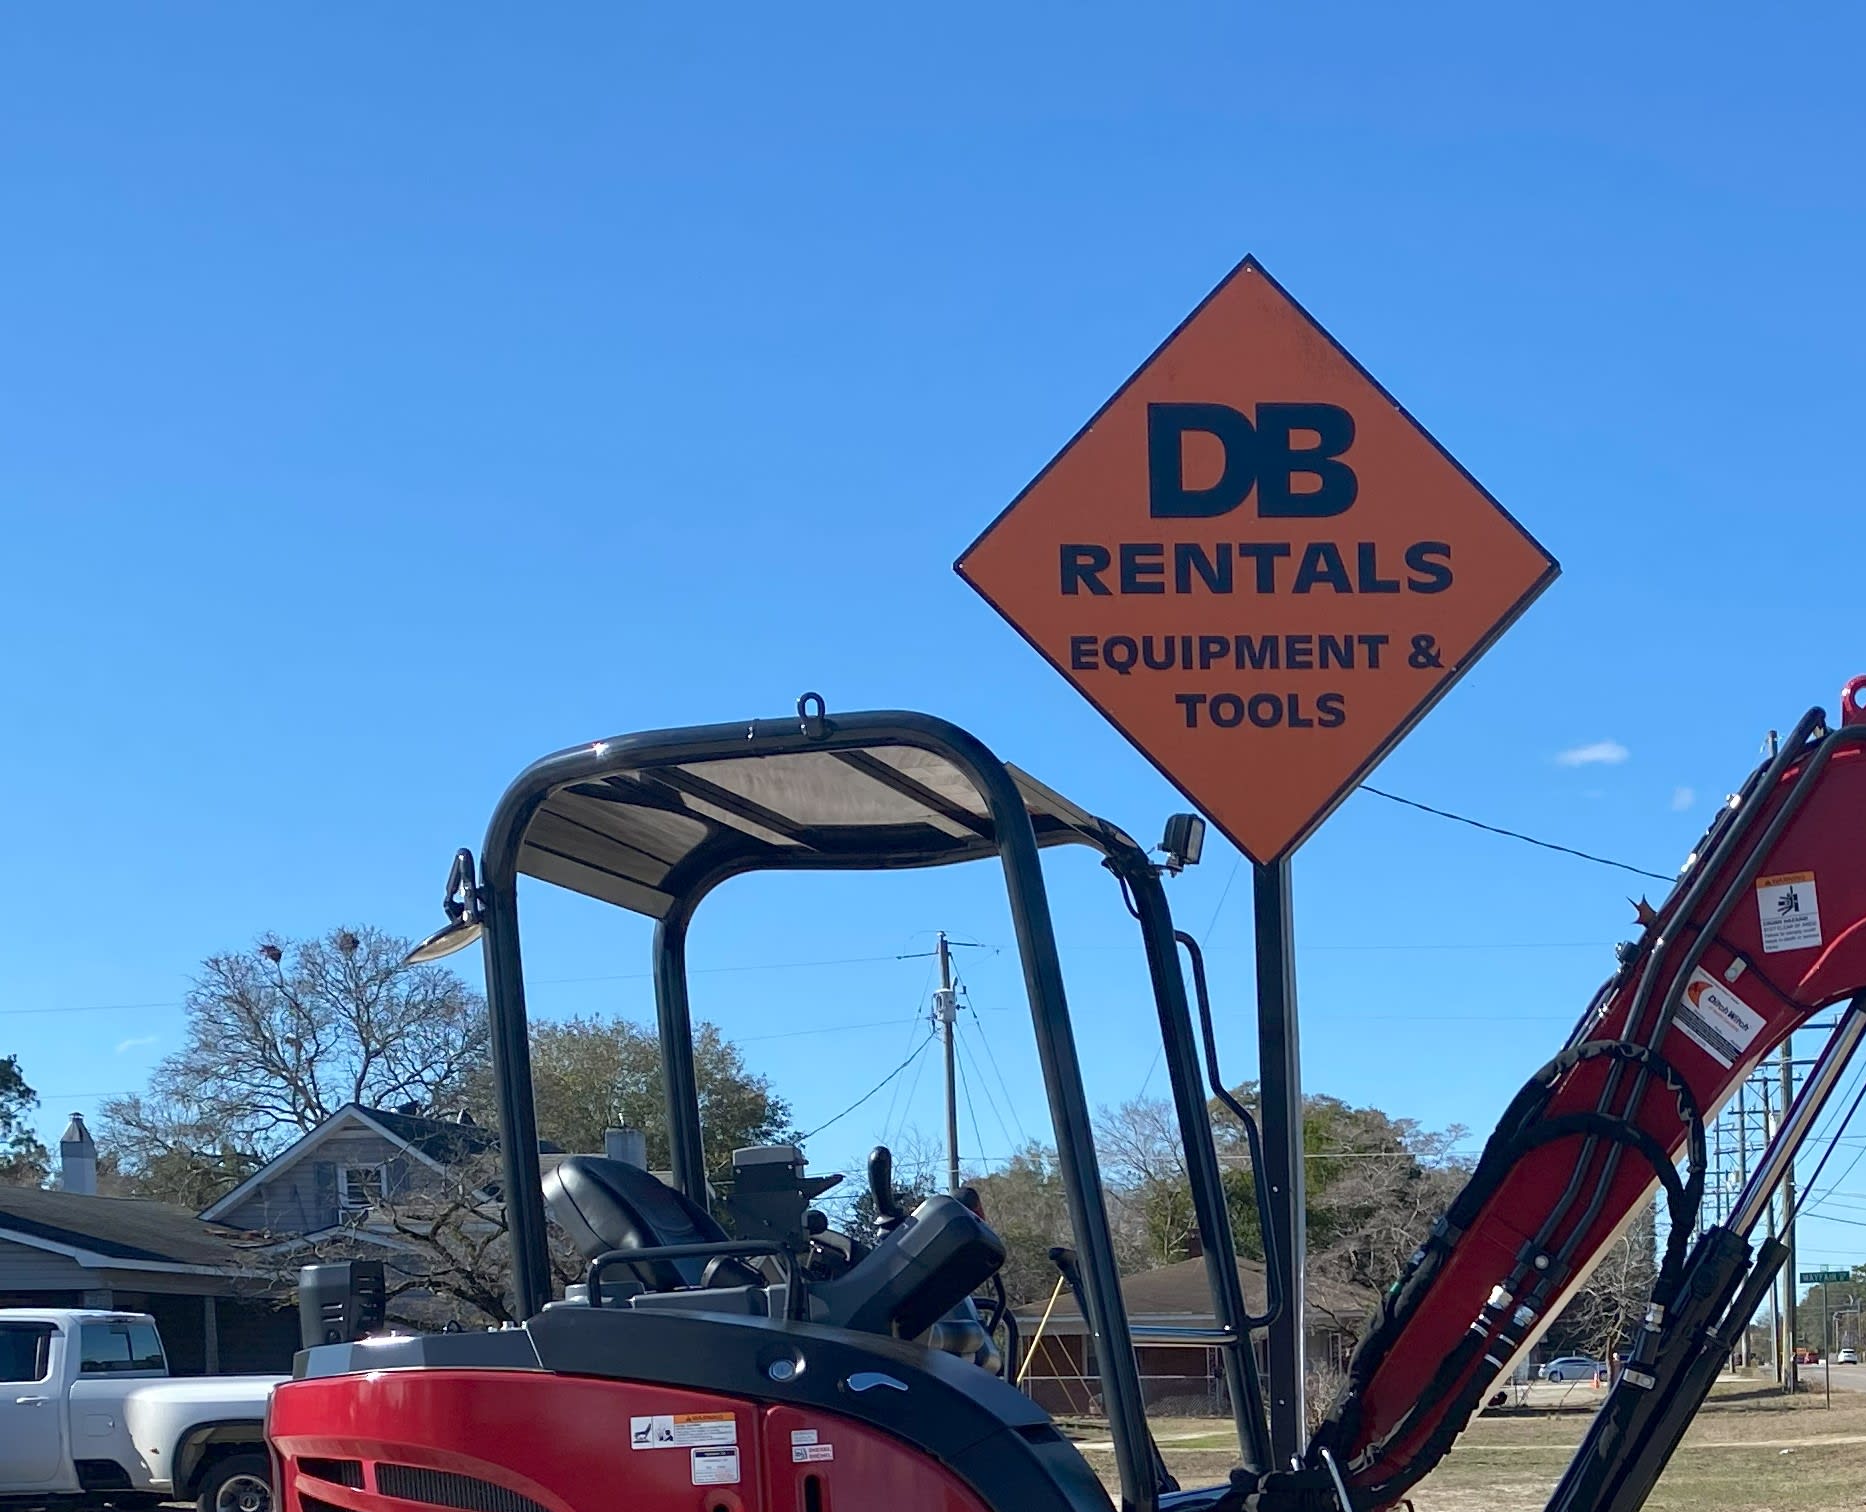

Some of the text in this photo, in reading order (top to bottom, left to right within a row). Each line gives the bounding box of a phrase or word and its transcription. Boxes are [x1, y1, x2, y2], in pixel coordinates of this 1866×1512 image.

[1147, 402, 1359, 519] DB
[1060, 541, 1454, 595] RENTALS
[1070, 633, 1446, 675] EQUIPMENT &
[1175, 692, 1347, 729] TOOLS
